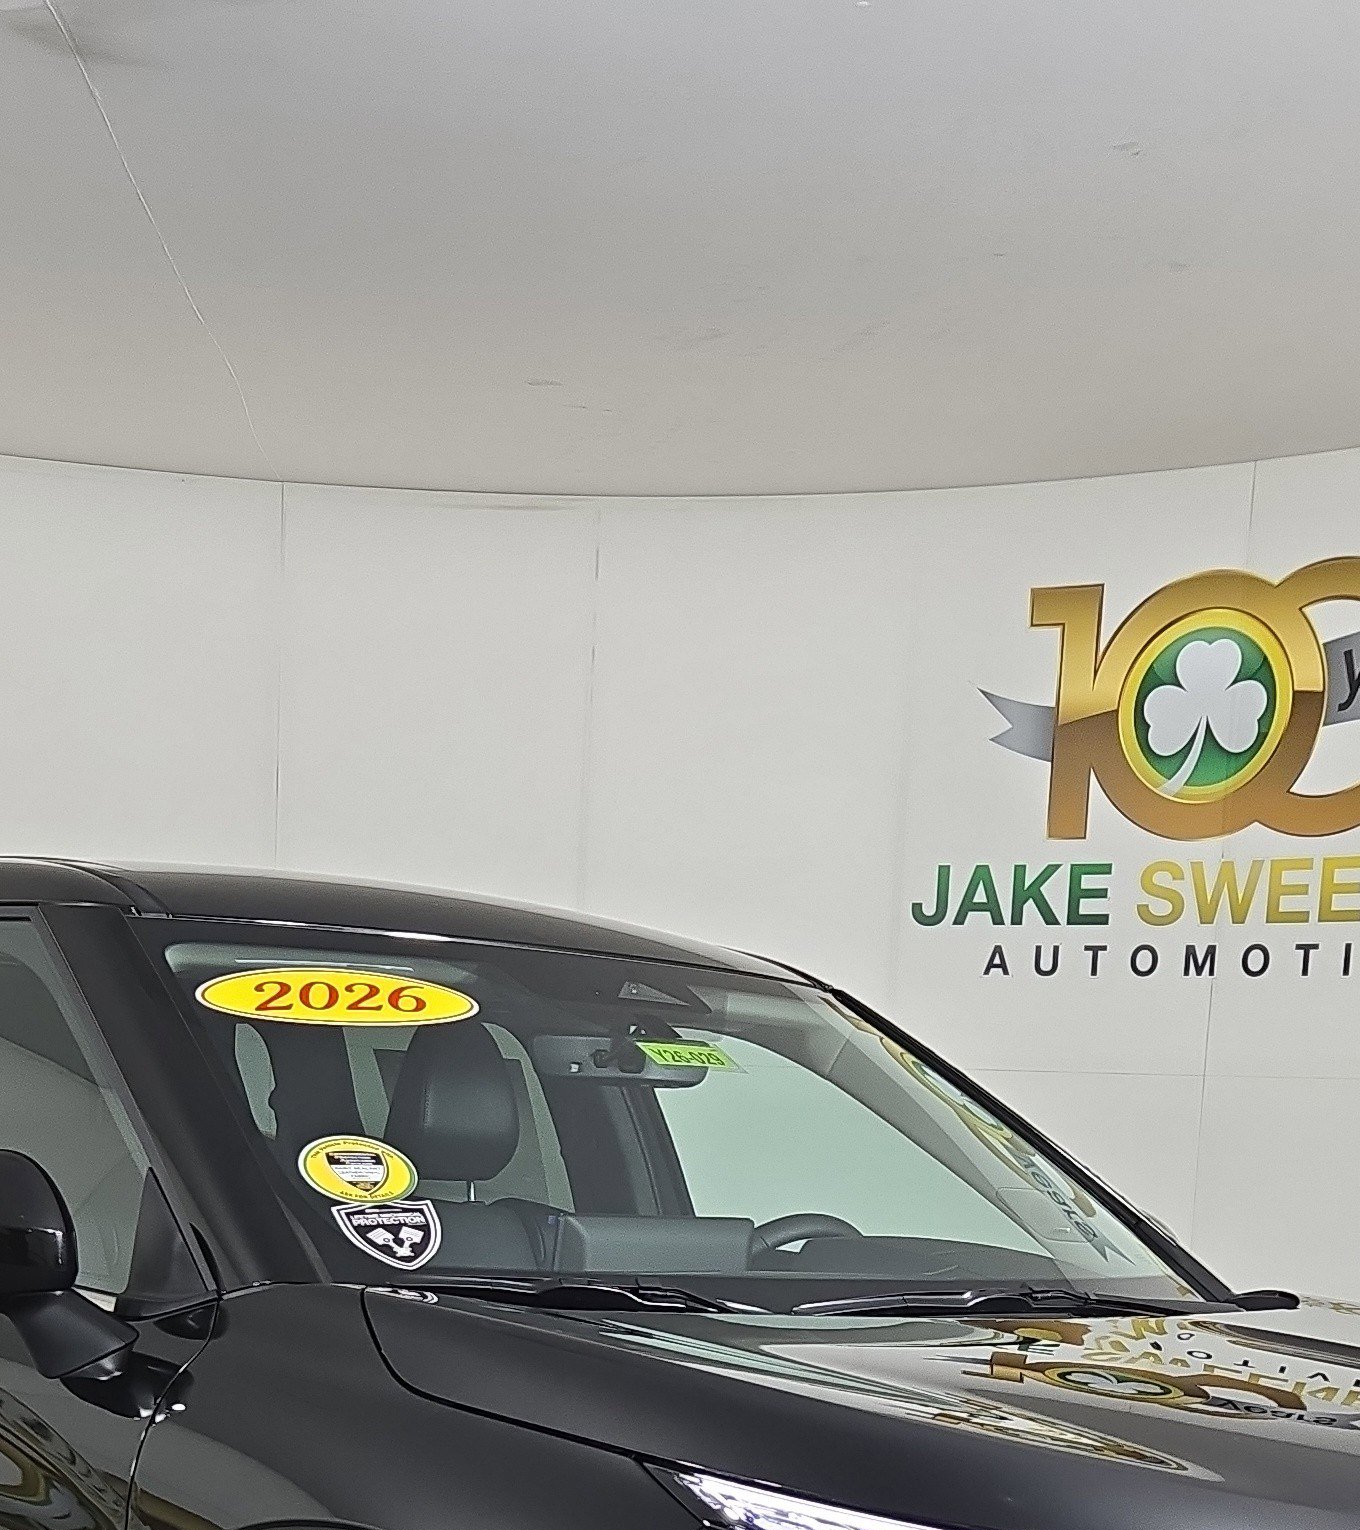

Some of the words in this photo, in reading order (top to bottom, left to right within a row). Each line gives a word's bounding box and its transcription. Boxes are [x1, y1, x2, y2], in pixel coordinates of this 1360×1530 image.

[910, 861, 1114, 928] JAKE
[253, 980, 427, 1014] 2026
[648, 1048, 726, 1066] Y26-029
[351, 1214, 427, 1228] PROTECTION
